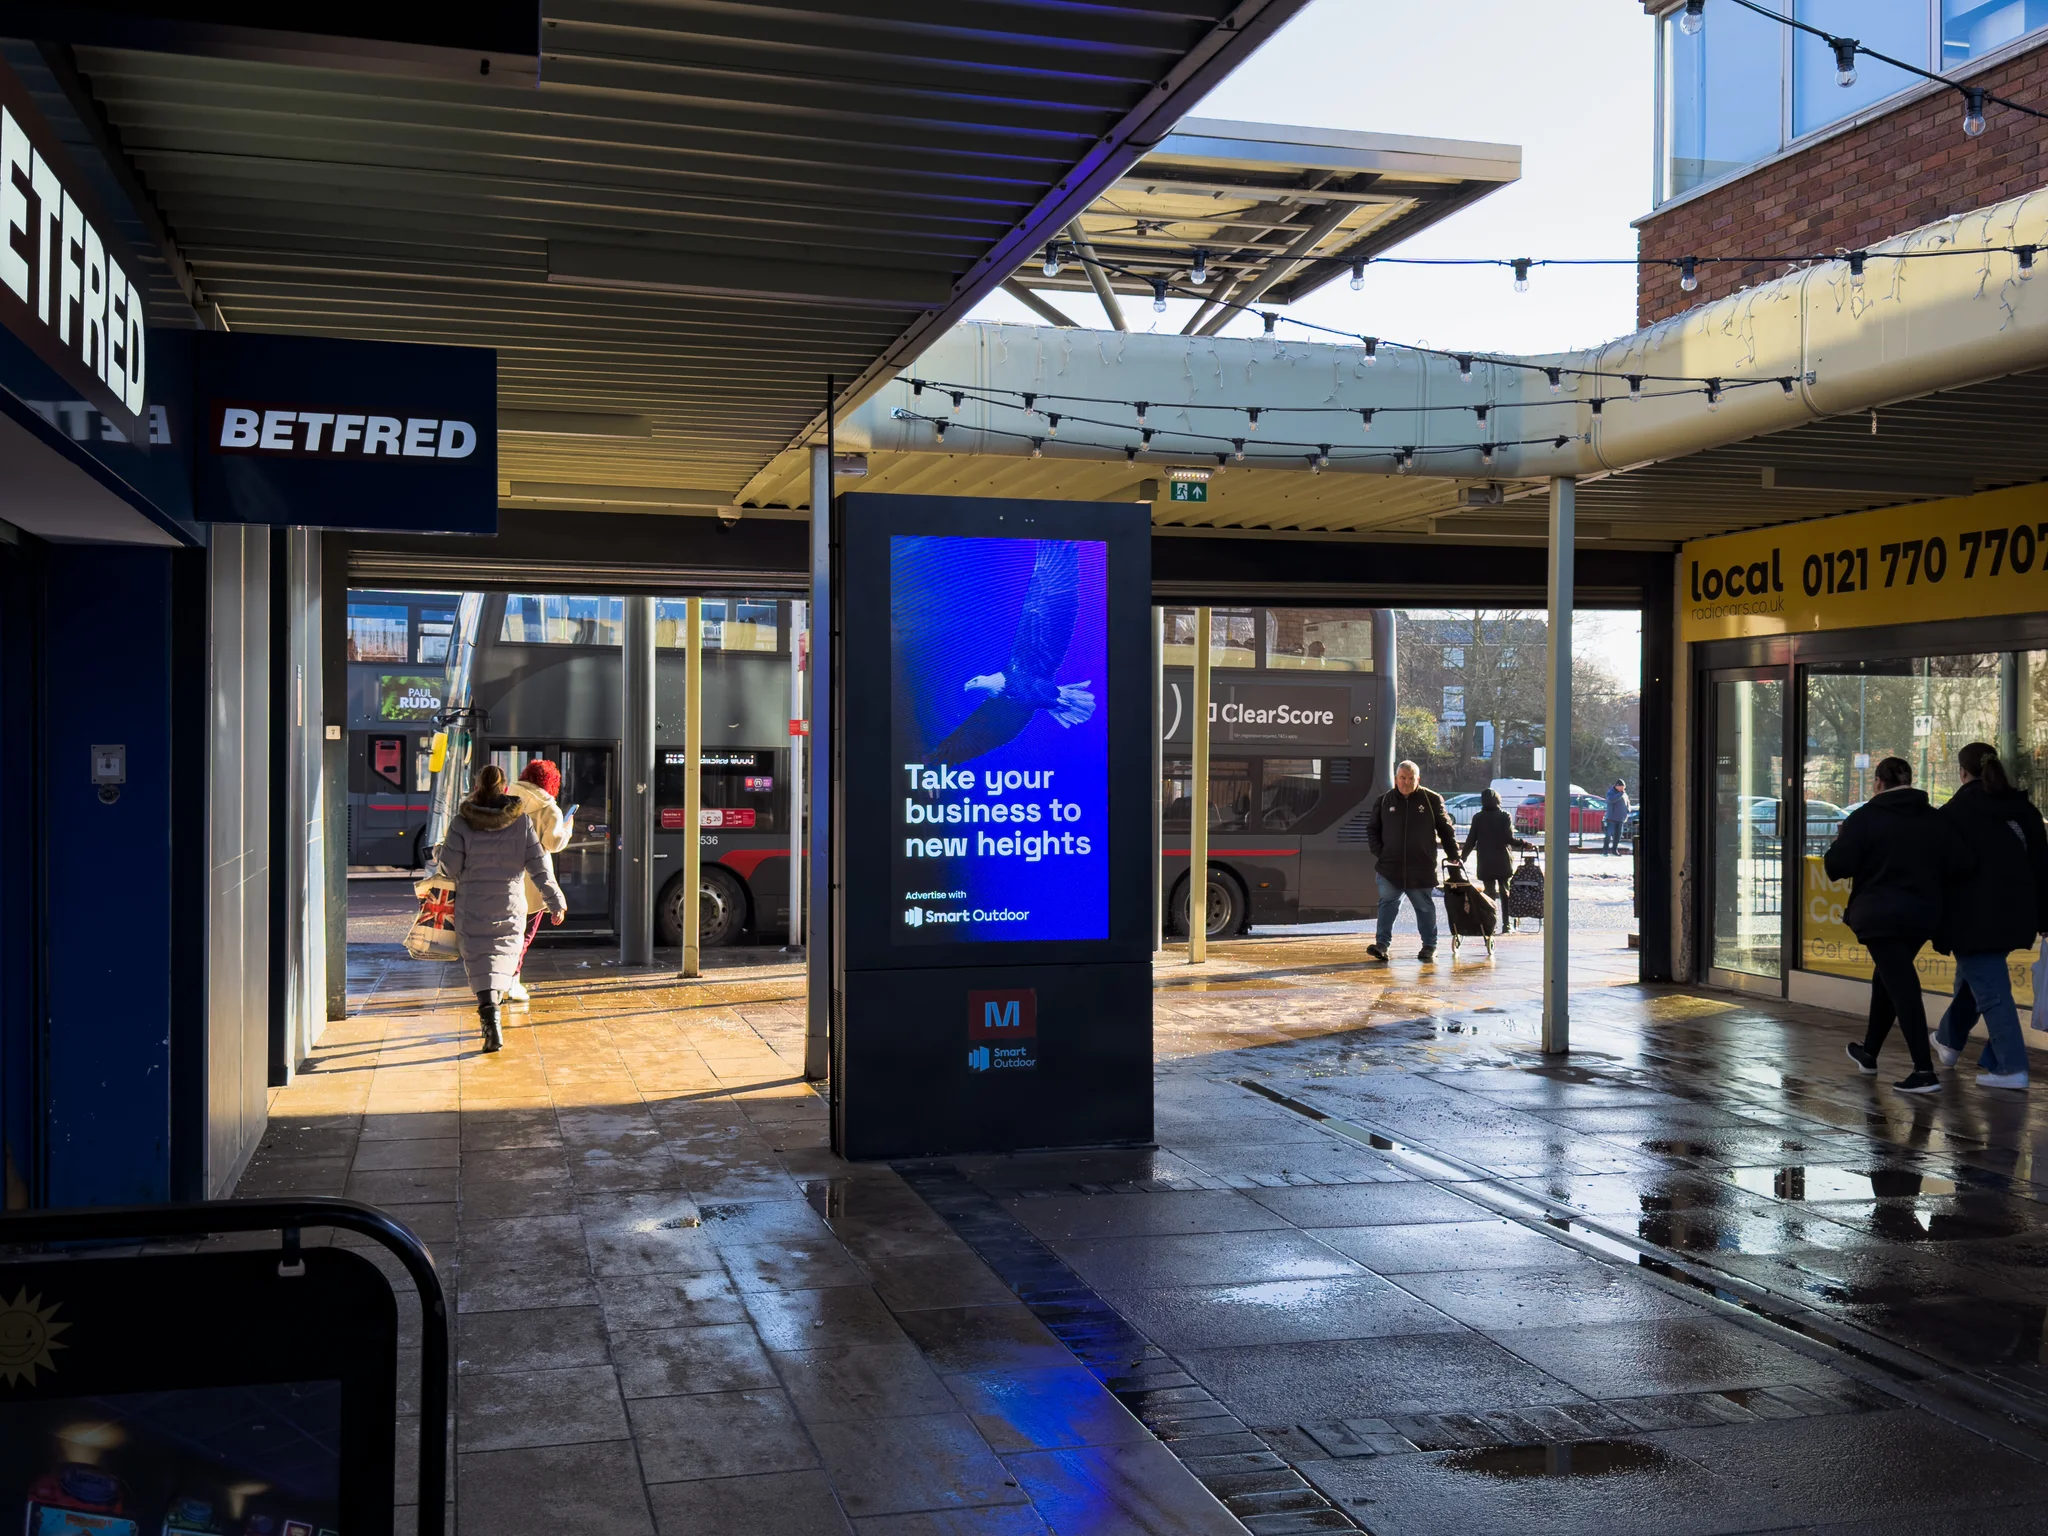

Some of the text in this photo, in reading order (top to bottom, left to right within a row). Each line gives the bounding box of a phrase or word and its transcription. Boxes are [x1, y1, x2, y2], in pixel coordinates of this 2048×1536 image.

[220, 408, 477, 459] BETFRED
[1691, 547, 1784, 602] local
[1803, 547, 1868, 597] 0121
[1880, 536, 1947, 589] 770
[1691, 594, 1785, 621] radiocars.co.uk
[399, 697, 441, 709] RUDD
[408, 688, 432, 698] PAUL
[1221, 703, 1334, 725] ClearScore
[904, 764, 1055, 796] Take your
[905, 797, 1082, 824] business to
[905, 830, 1092, 862] new heights
[905, 890, 967, 900] Advertise with
[925, 908, 1030, 923] Smart Outdoor
[1811, 937, 1843, 960] Get
[985, 1000, 1020, 1028] M
[993, 1058, 1036, 1068] Outdoor
[994, 1047, 1027, 1057] Smart
